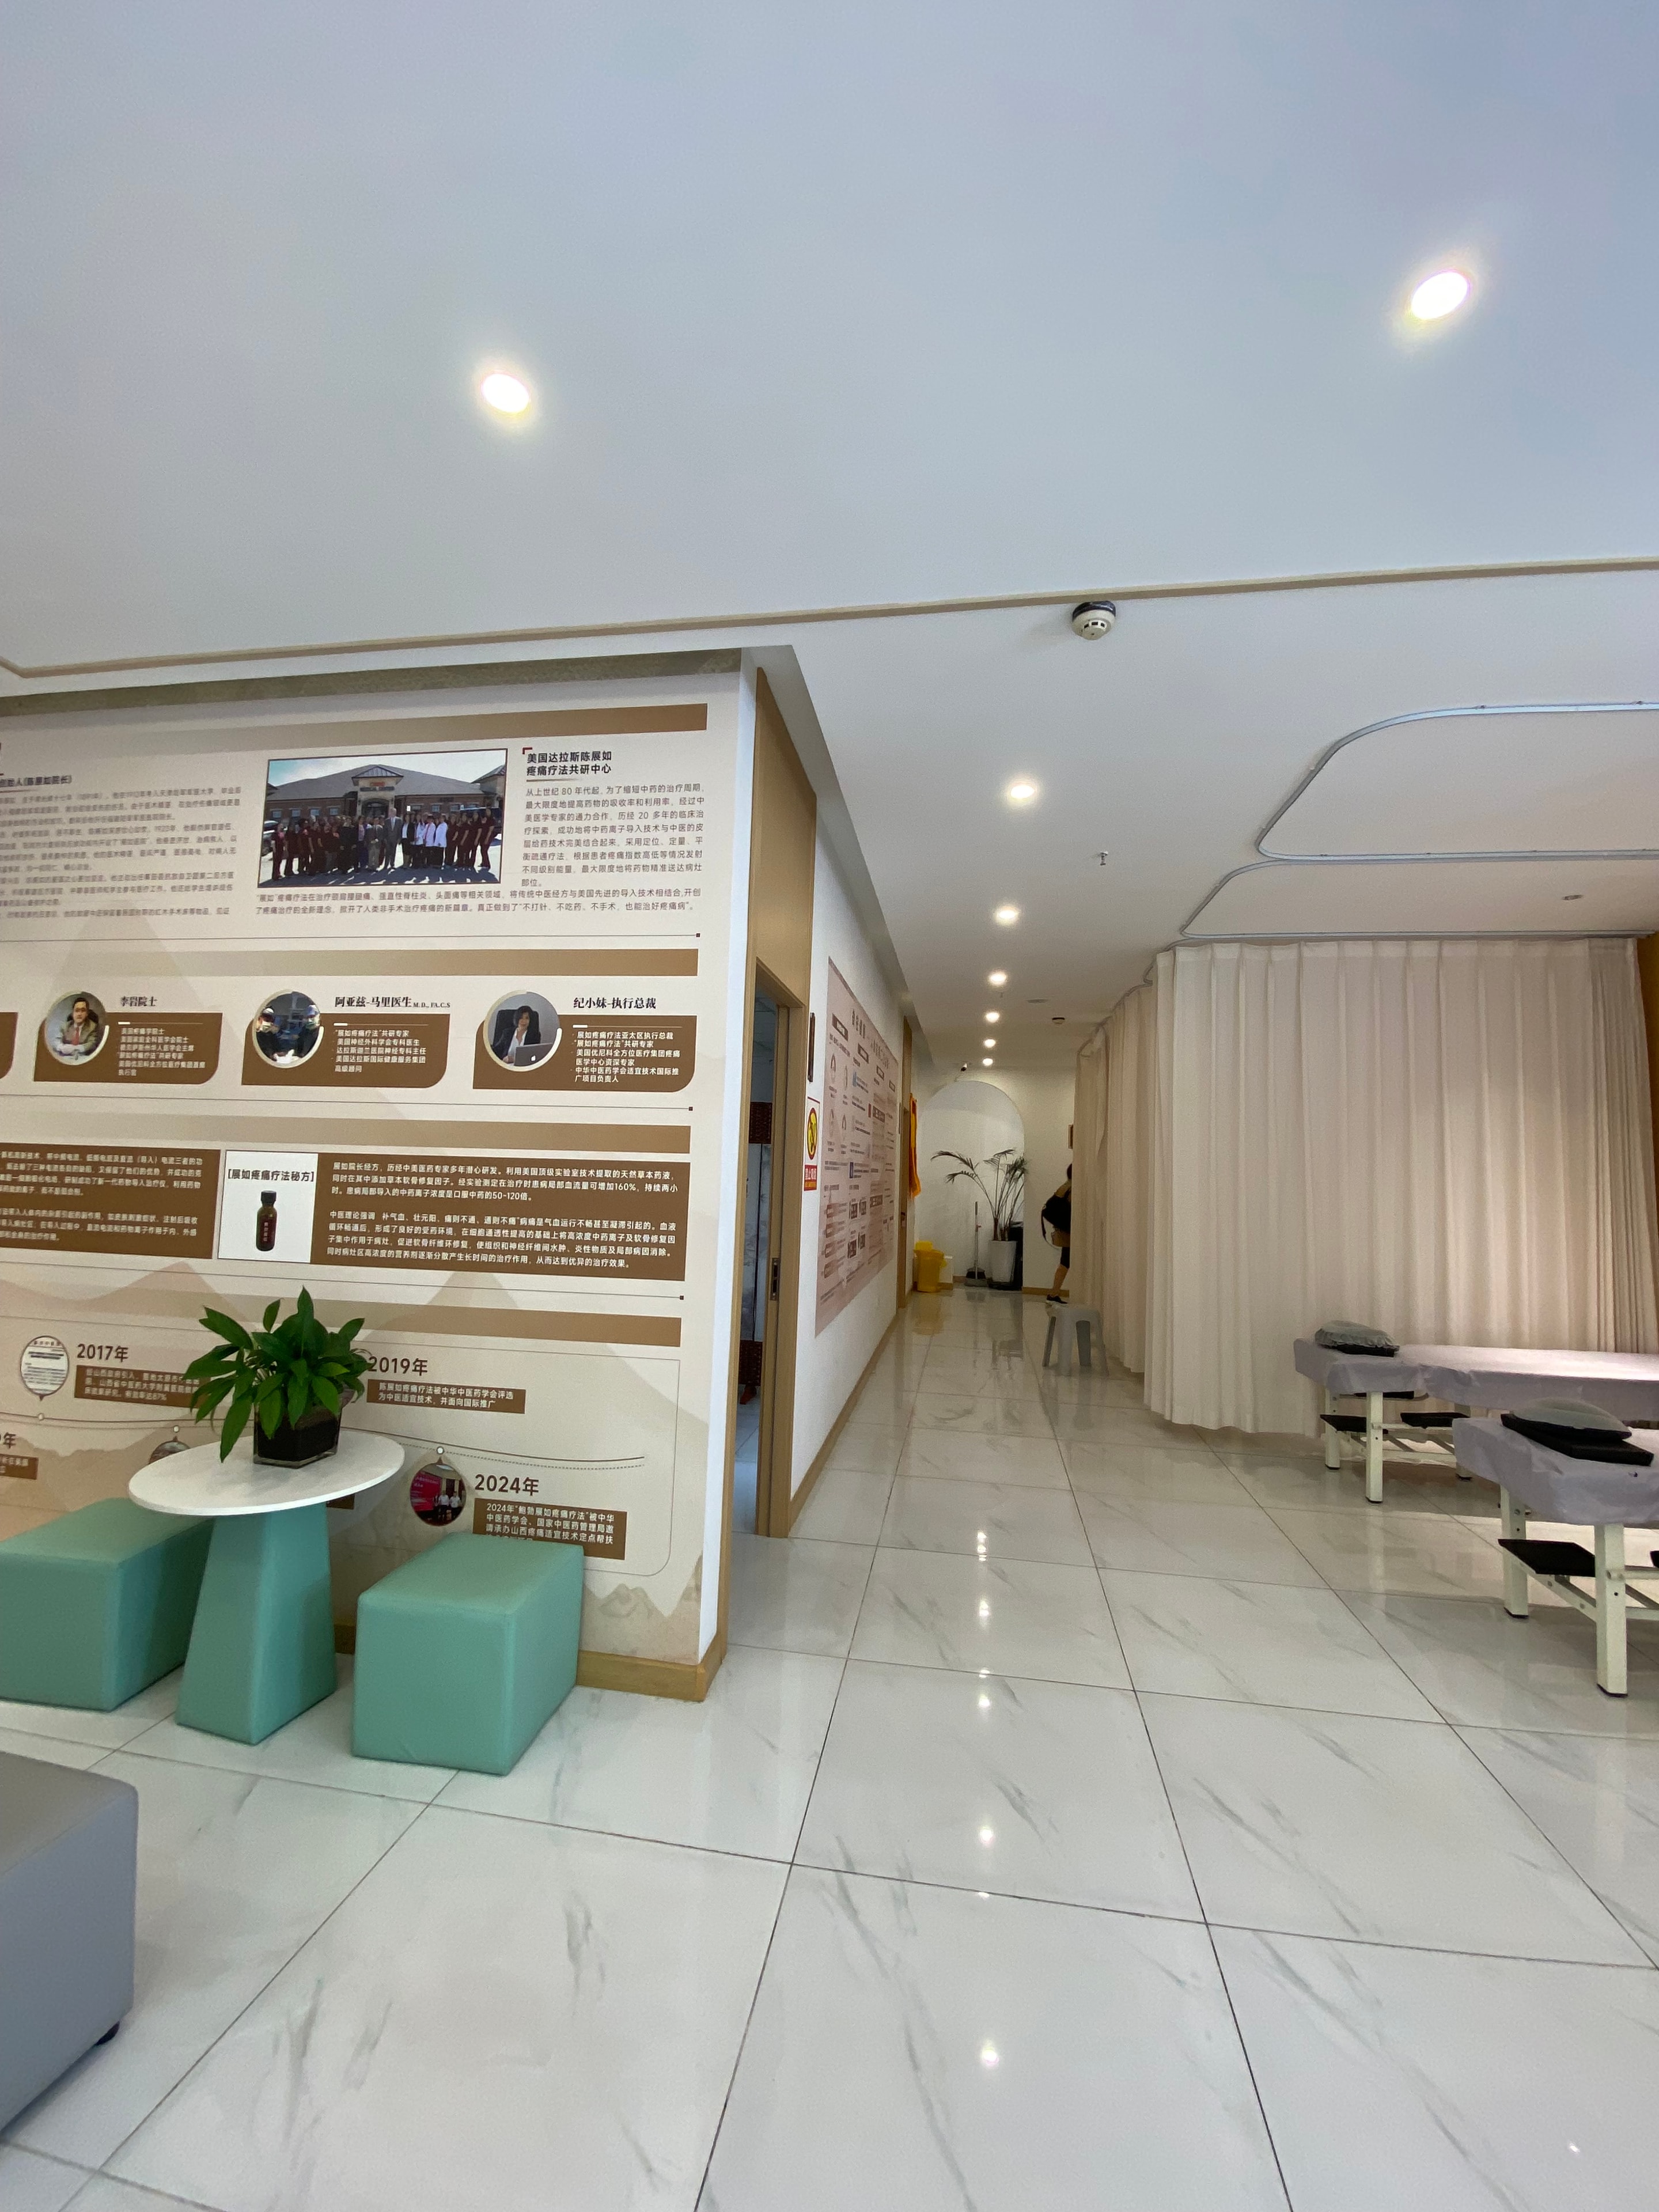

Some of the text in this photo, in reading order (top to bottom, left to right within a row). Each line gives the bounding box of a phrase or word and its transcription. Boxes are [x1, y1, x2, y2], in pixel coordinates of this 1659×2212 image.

[527, 751, 612, 764] 美国达拉斯陈展如
[526, 763, 612, 777] 疼痛疗法共研中心
[573, 997, 657, 1009] 纪小妹-执行总裁
[577, 1031, 674, 1040] 展如疼痛疗法亚太区执行总裁
[576, 1048, 681, 1058] 美国优尼科全方位医疗集团疼痛
[576, 1058, 635, 1066] 医学中心资深专家
[574, 1074, 619, 1083] 广项目负责人
[77, 1343, 128, 1363] 2017年
[368, 1355, 428, 1377] 2019年
[474, 1474, 540, 1497] 2024年
